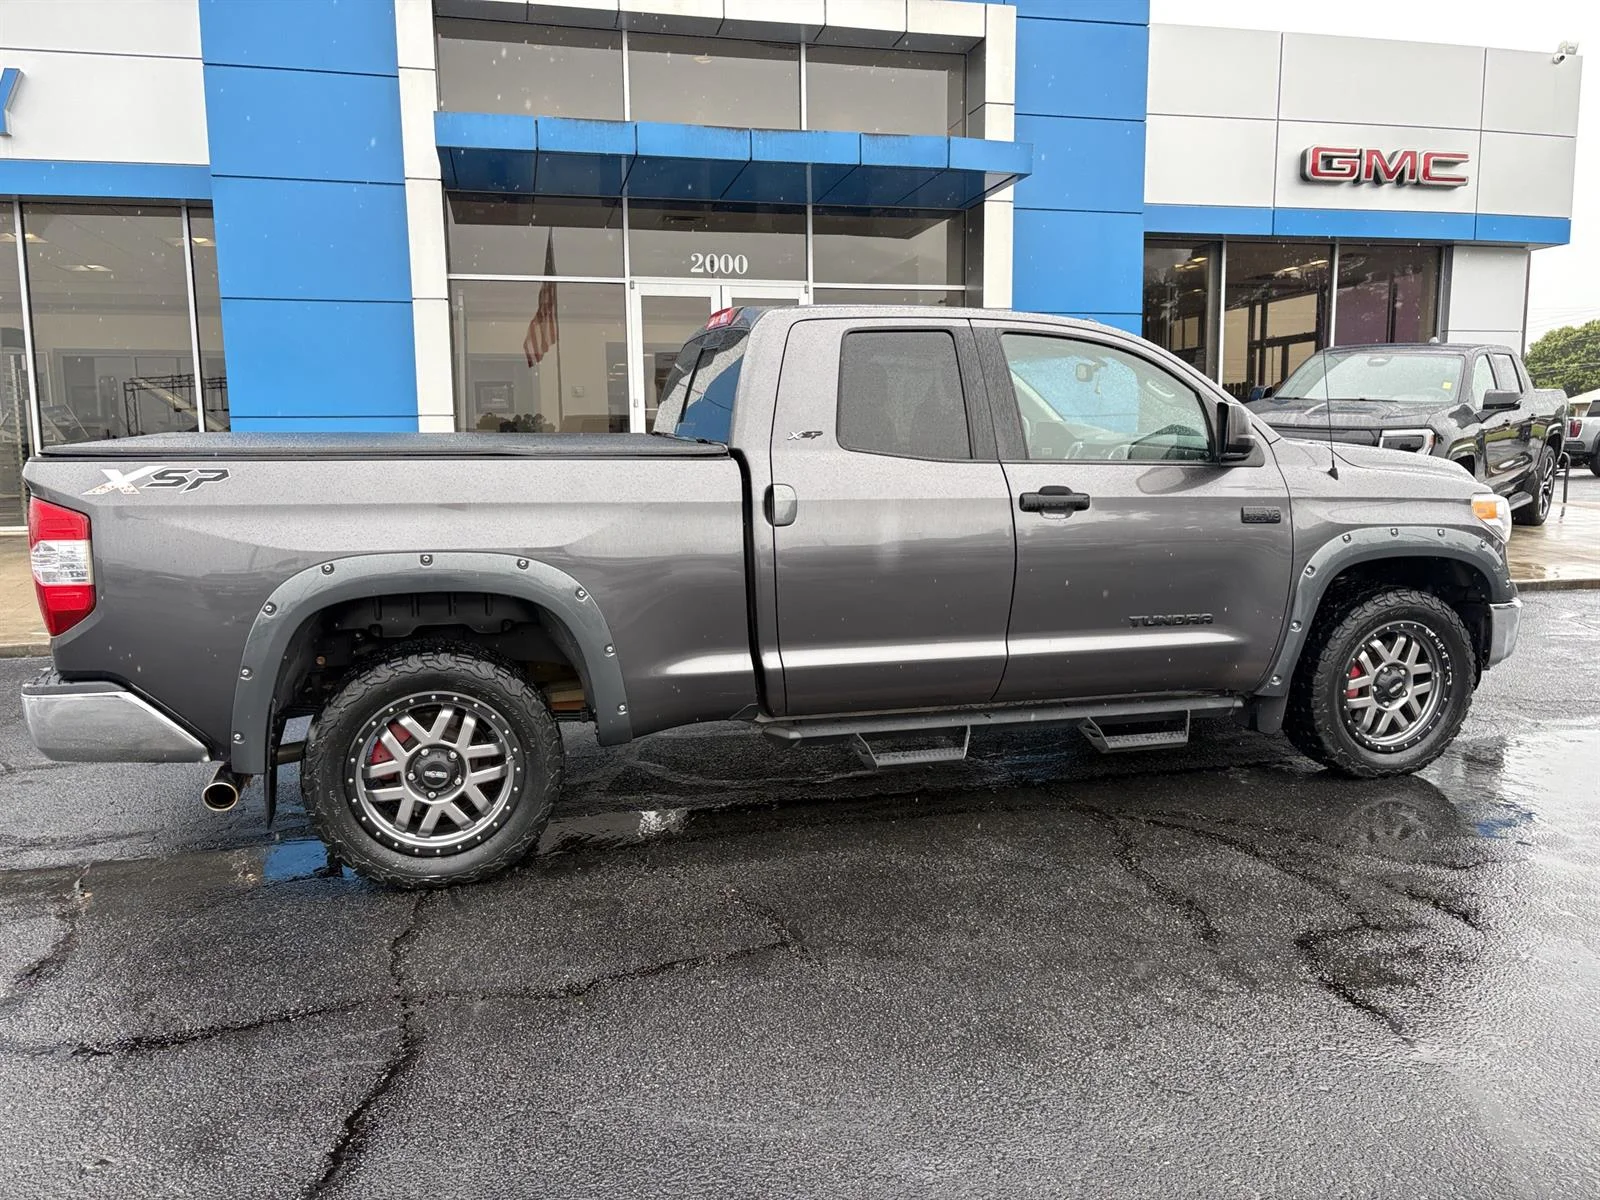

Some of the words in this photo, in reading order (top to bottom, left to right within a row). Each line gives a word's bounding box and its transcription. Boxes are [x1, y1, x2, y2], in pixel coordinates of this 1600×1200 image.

[1301, 144, 1469, 187] GMC
[690, 252, 749, 275] 2000
[1128, 613, 1214, 627] TUNDRA
